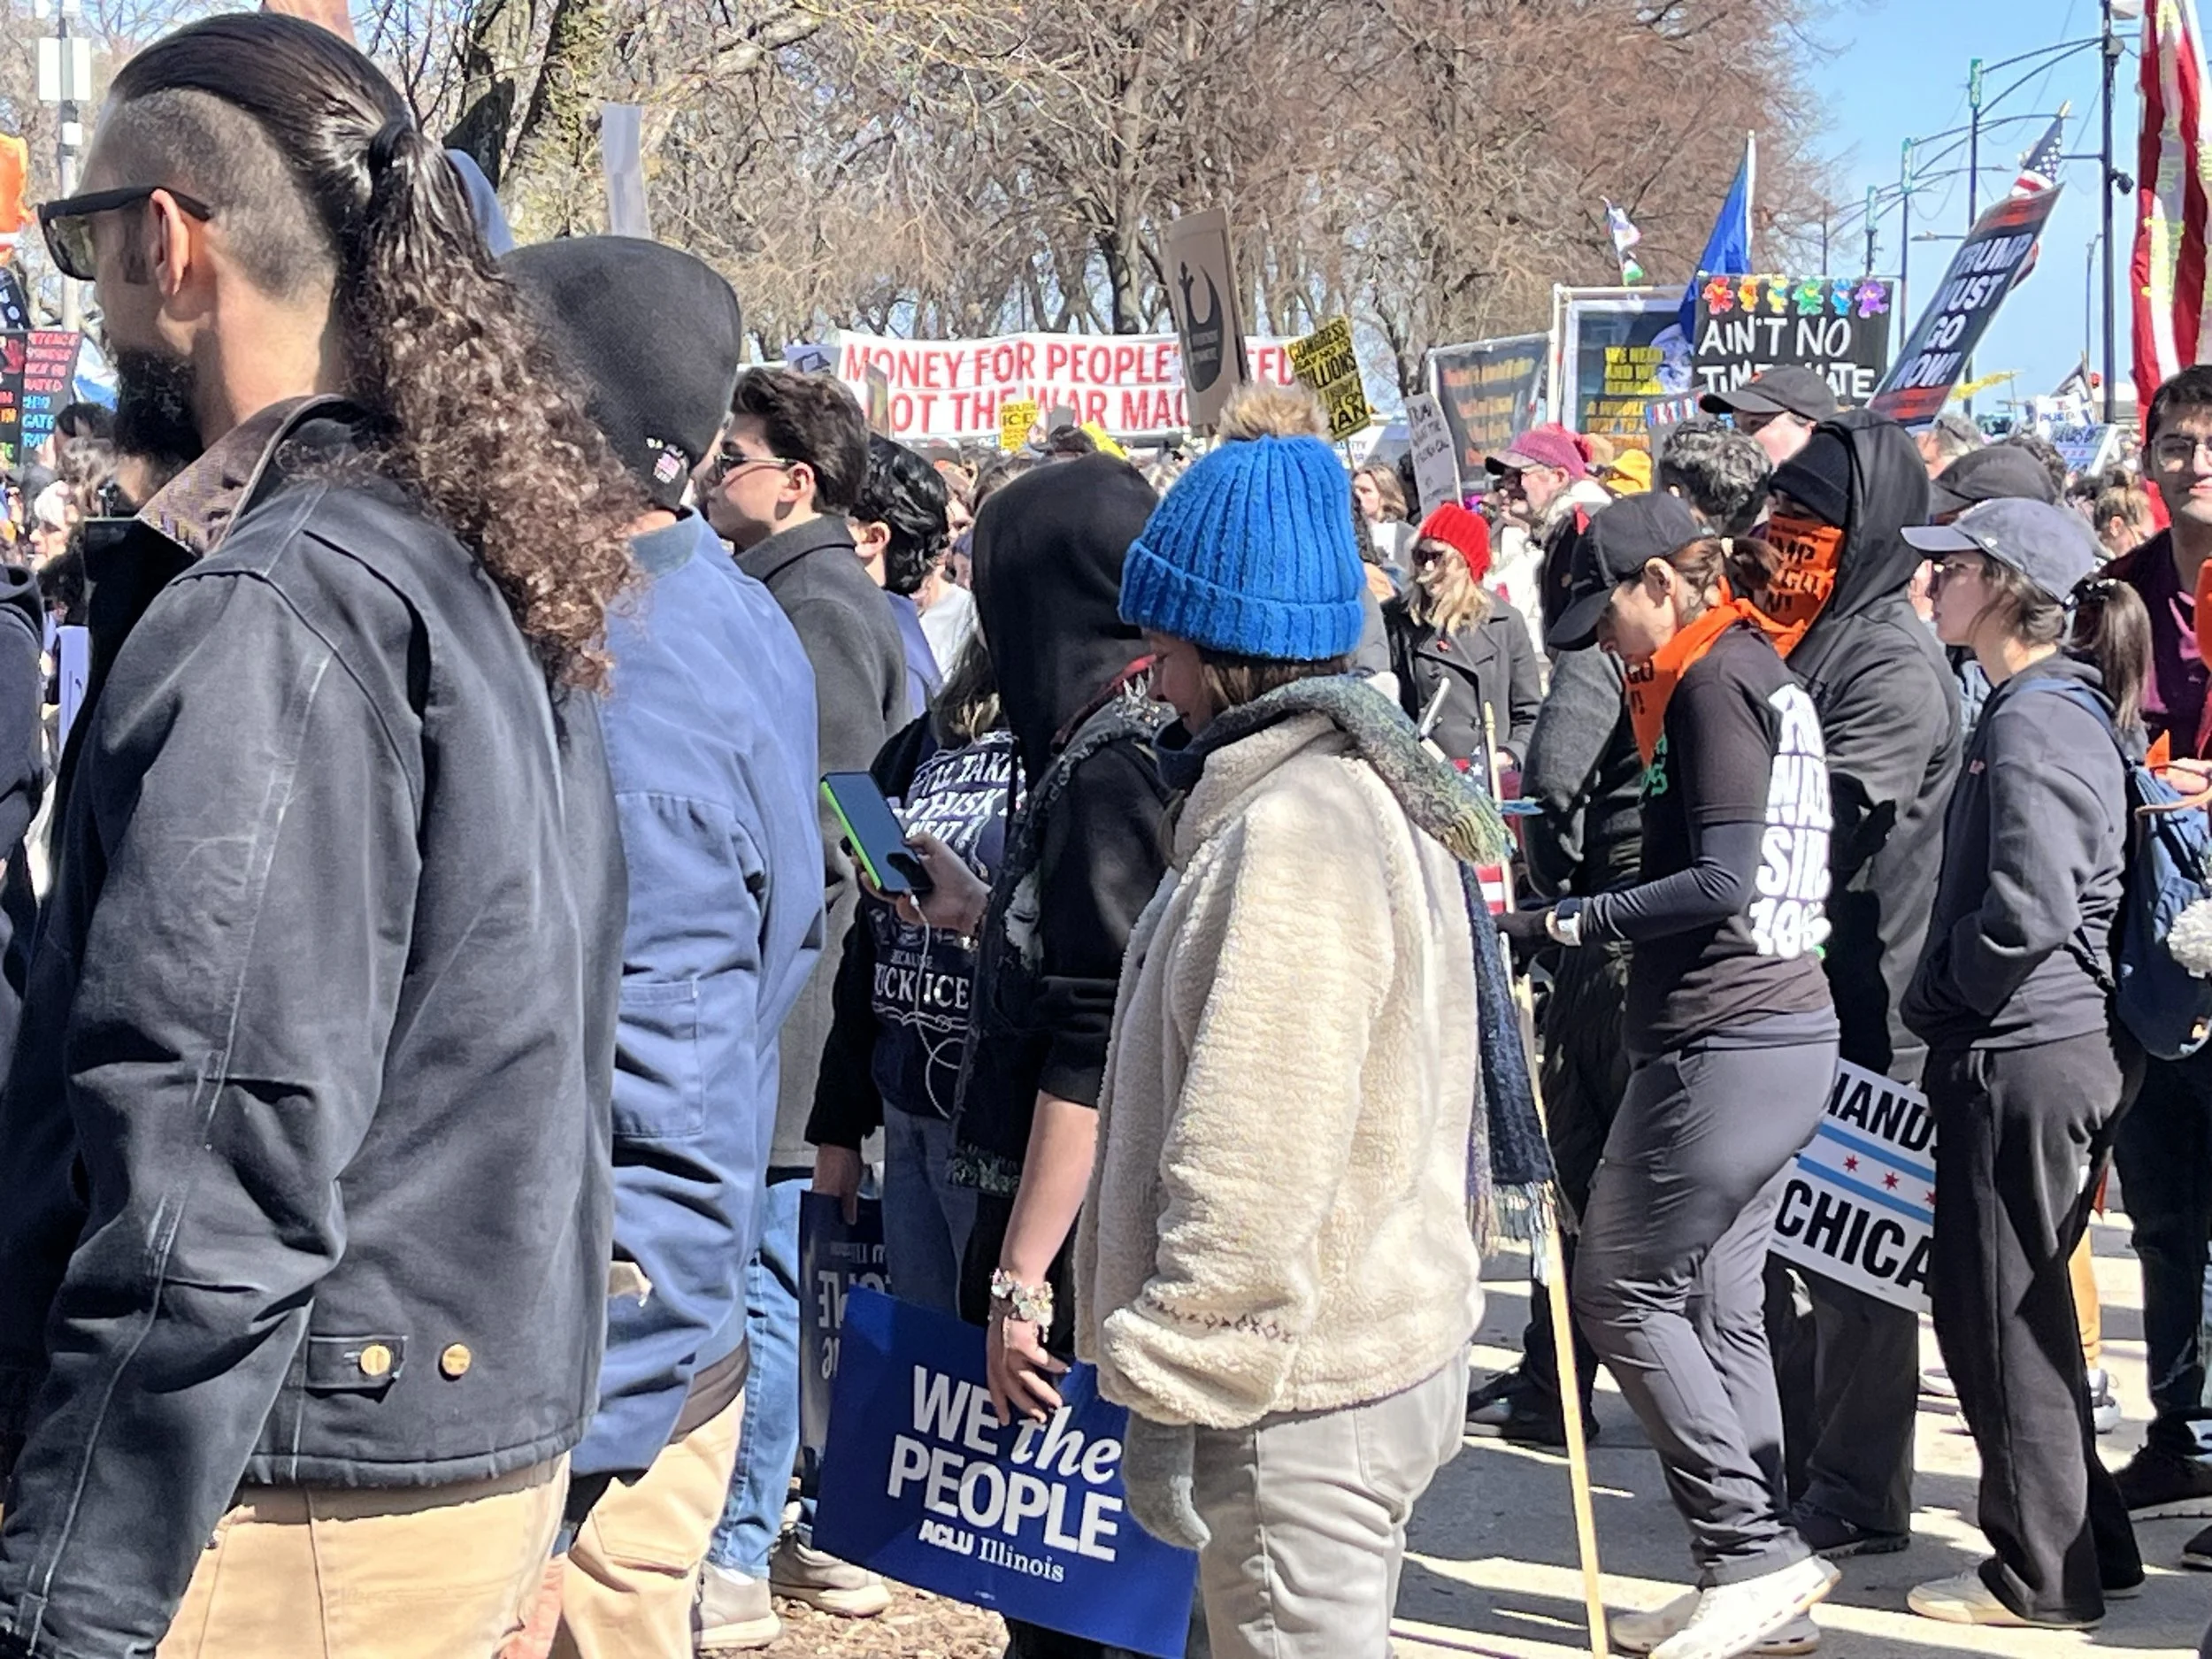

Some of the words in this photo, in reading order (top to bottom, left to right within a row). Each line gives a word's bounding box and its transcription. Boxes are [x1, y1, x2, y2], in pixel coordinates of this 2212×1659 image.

[1949, 232, 2035, 279] TRUMP
[1698, 315, 1788, 356] AIN'T
[1796, 317, 1852, 357] NO
[1924, 313, 1967, 349] GO
[845, 343, 964, 389] MONEY
[974, 340, 1035, 386] FOR
[1047, 342, 1179, 385] PEOPLE'
[1806, 361, 1875, 398] ATE
[1889, 351, 1962, 392] NOW!
[874, 963, 917, 1002] UCK
[923, 973, 970, 1010] ICE
[1828, 1071, 1935, 1152] AND
[1774, 1179, 1934, 1295] CHICA
[913, 1364, 999, 1455] WE
[1010, 1405, 1122, 1485] the
[887, 1433, 1123, 1563] PEOPLE
[918, 1518, 974, 1555] ACLU
[978, 1536, 1064, 1583] Illinois
